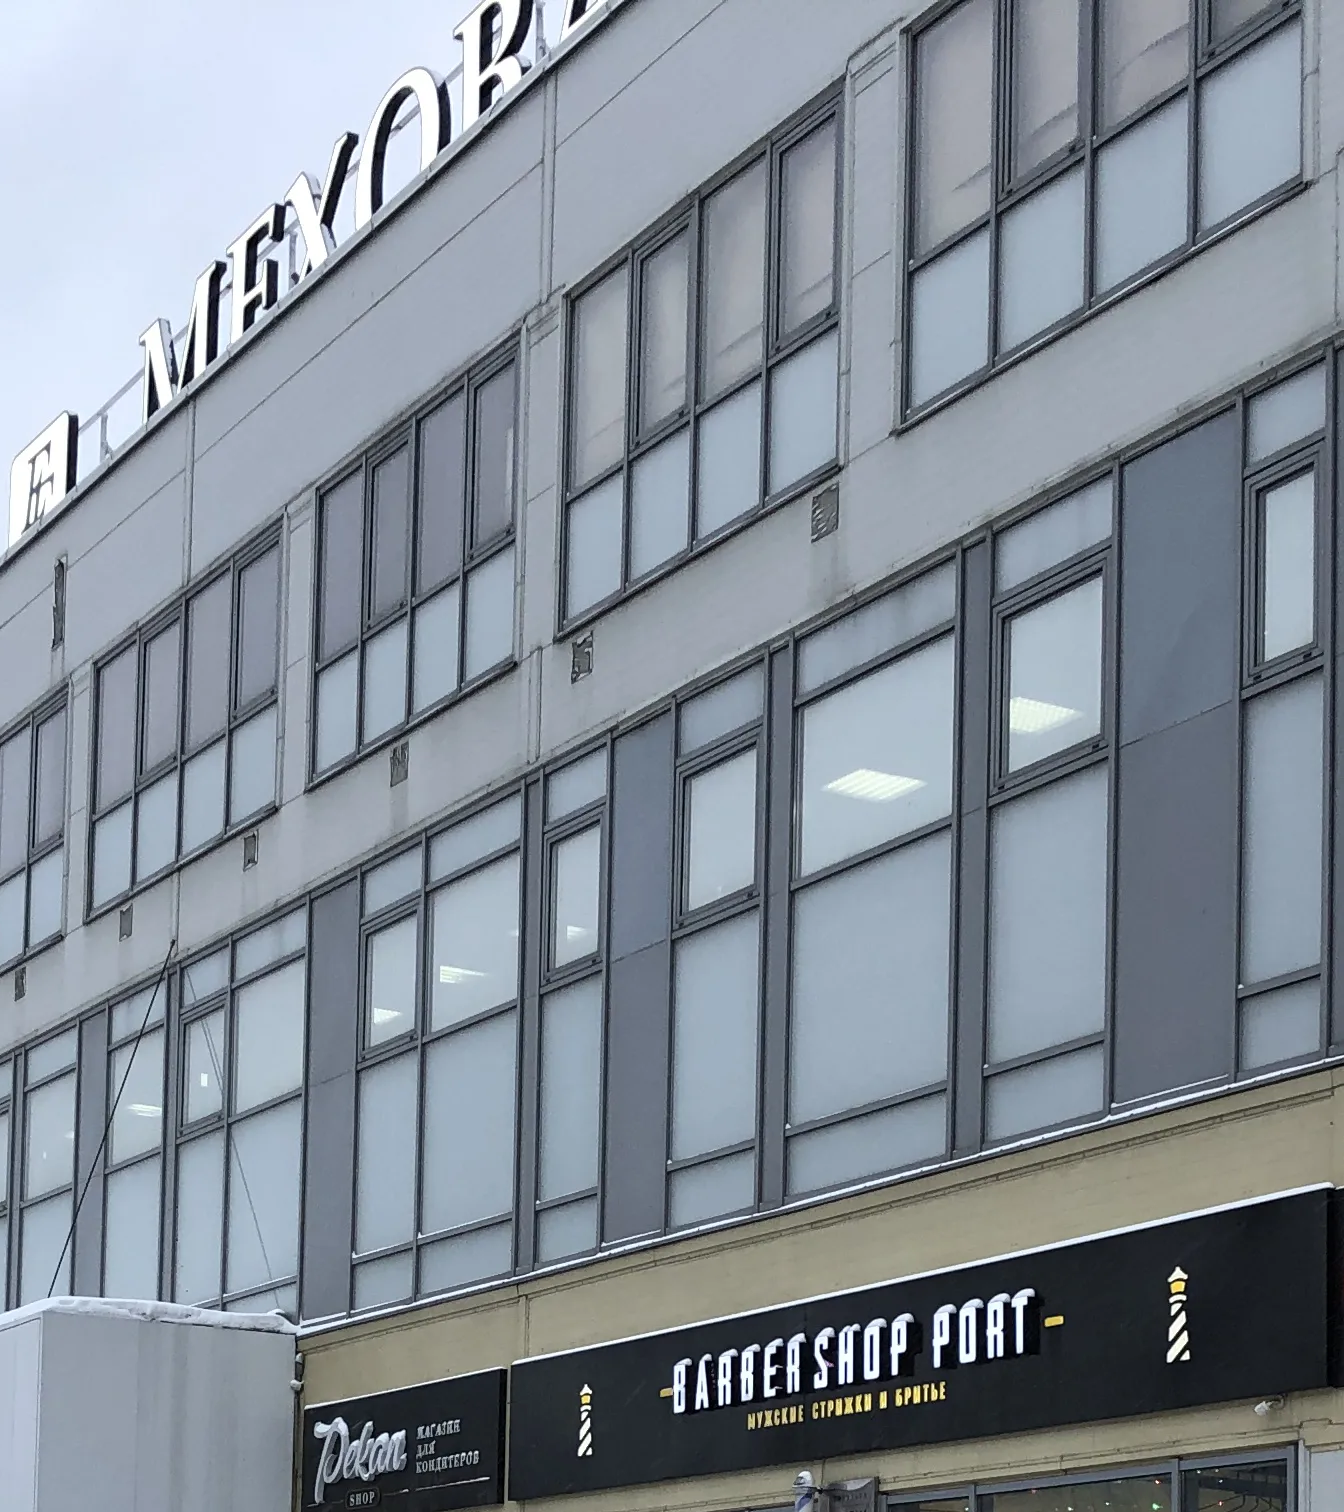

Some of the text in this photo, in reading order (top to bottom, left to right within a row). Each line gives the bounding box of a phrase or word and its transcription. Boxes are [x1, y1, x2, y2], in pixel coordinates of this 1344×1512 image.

[139, 0, 606, 425] МЕХОВ
[672, 1291, 1033, 1414] BARBERSHOP PORT
[747, 1381, 946, 1430] МУЖСКИЕ СТРИЖКИ И БРИТЬЕ
[416, 1419, 460, 1439] МАГАЗИН
[416, 1440, 436, 1459] ДЛЯ
[416, 1450, 479, 1474] КОНДИТЕРОВ
[349, 1491, 375, 1507] SHOP
